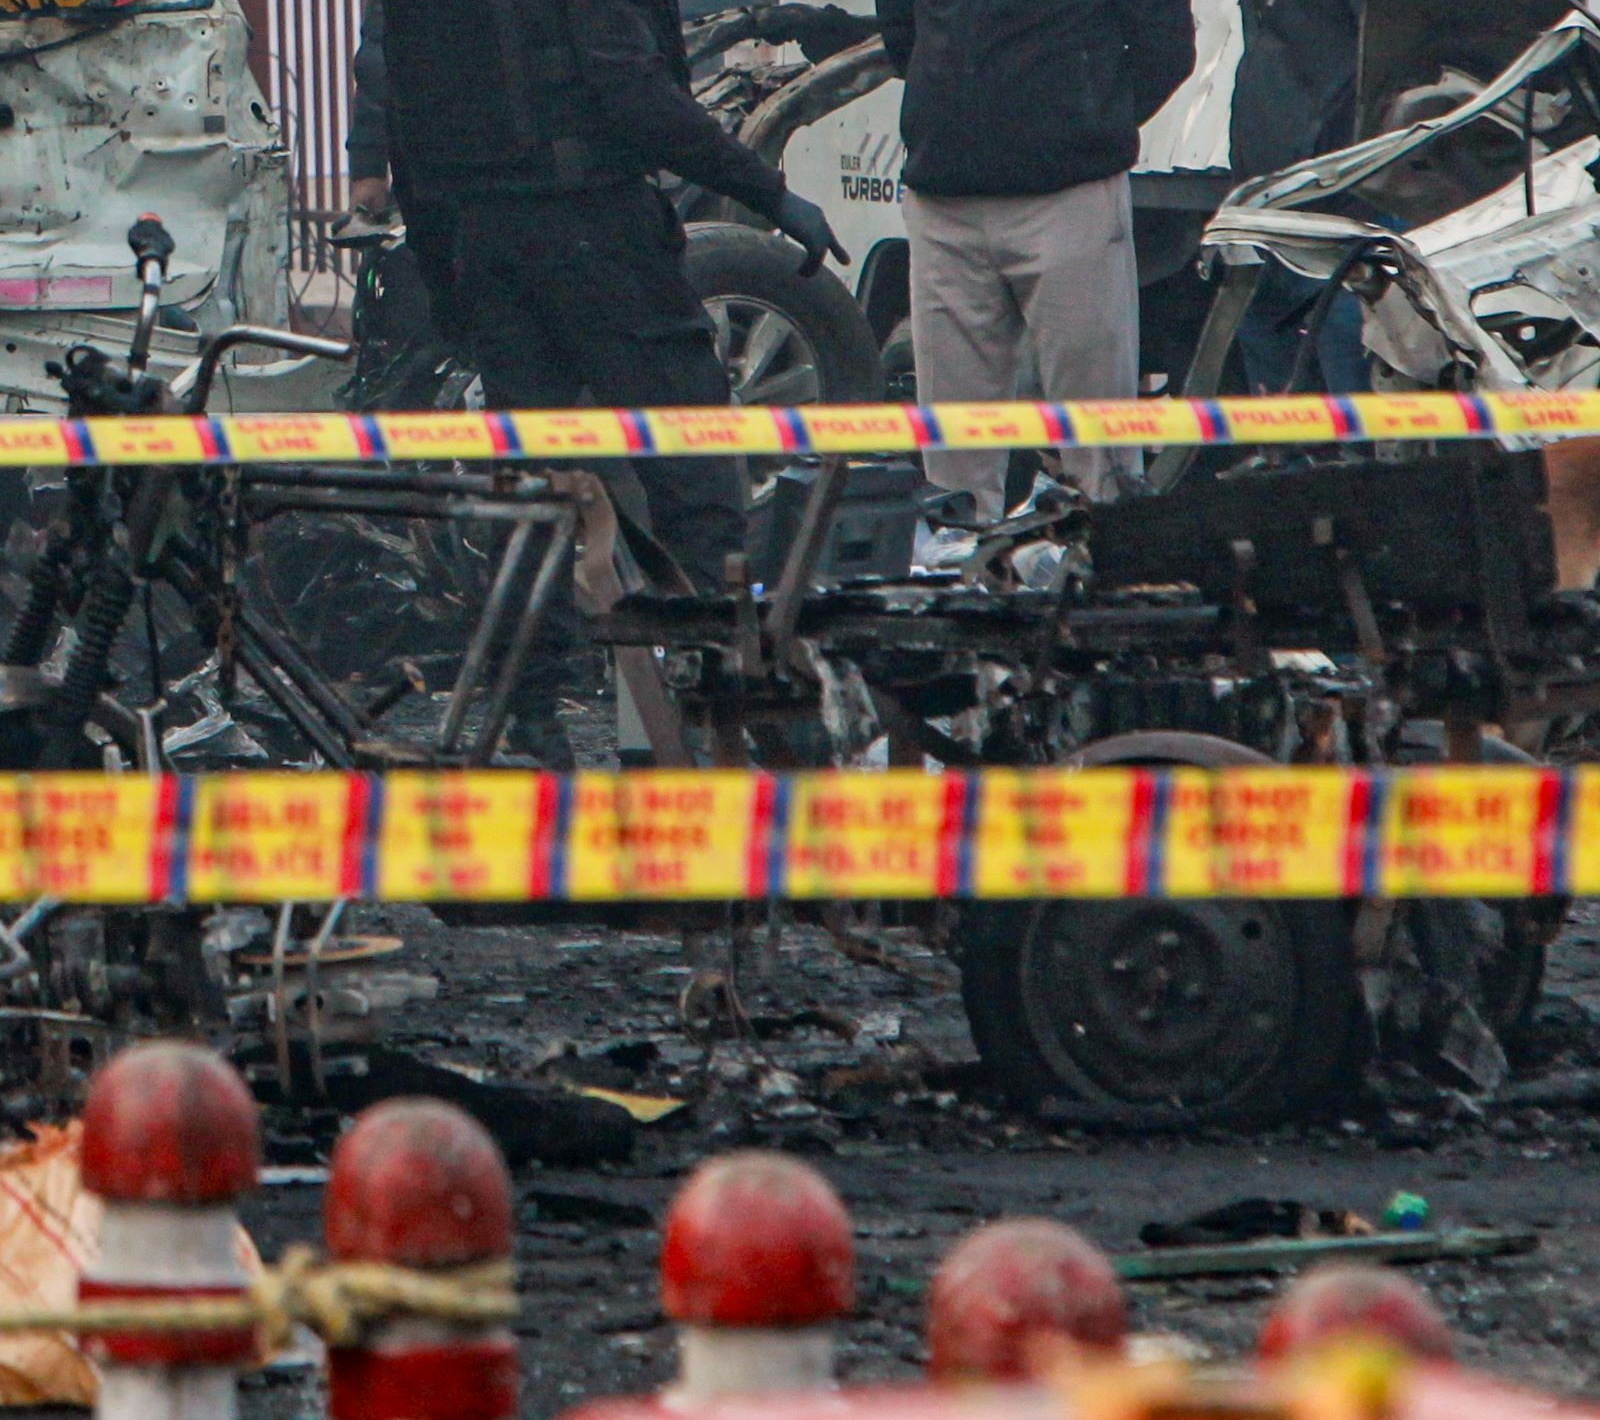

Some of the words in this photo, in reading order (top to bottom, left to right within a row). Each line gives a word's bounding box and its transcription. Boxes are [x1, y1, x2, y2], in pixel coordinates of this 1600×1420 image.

[841, 176, 894, 203] TURBO
[1232, 410, 1321, 425] POLICE
[1521, 410, 1581, 425] LINE
[389, 427, 479, 443] POLICE
[811, 419, 900, 435] POLICE
[1103, 420, 1163, 435] LINE
[258, 436, 318, 451] LINE
[683, 430, 743, 445] LINE
[196, 846, 323, 879] POLICE
[793, 846, 919, 877] POLICE
[1386, 843, 1517, 873] POLICE
